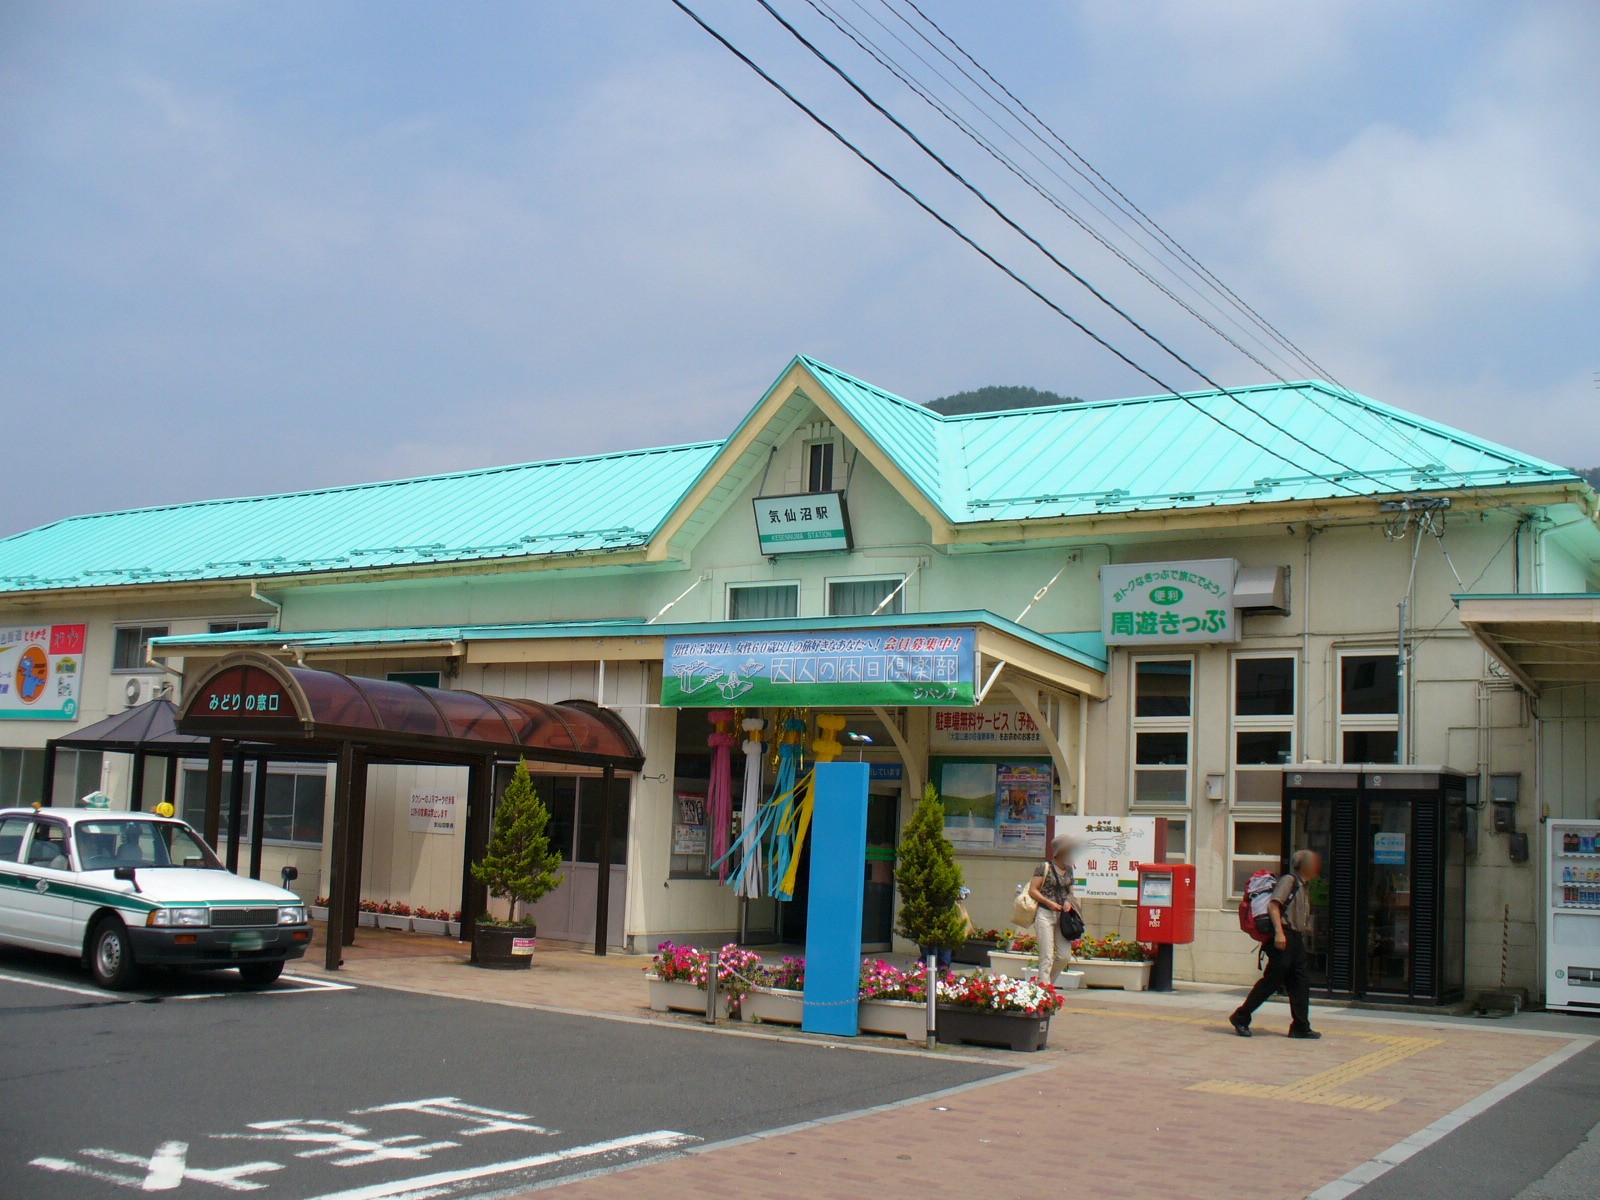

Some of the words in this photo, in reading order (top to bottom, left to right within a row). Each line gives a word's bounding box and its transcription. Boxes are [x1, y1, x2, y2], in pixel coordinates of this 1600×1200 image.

[768, 506, 828, 523] 気仙沼駅
[771, 533, 804, 541] KESENNUMA
[807, 531, 832, 539] STATION
[1111, 609, 1226, 636] 周遊きっぷ
[884, 636, 961, 651] 会員募集中！
[771, 655, 958, 683] 大人の休日倶楽部
[912, 687, 958, 700] ジパング
[209, 693, 279, 711] みどりの窓口
[1149, 920, 1161, 928] POST
